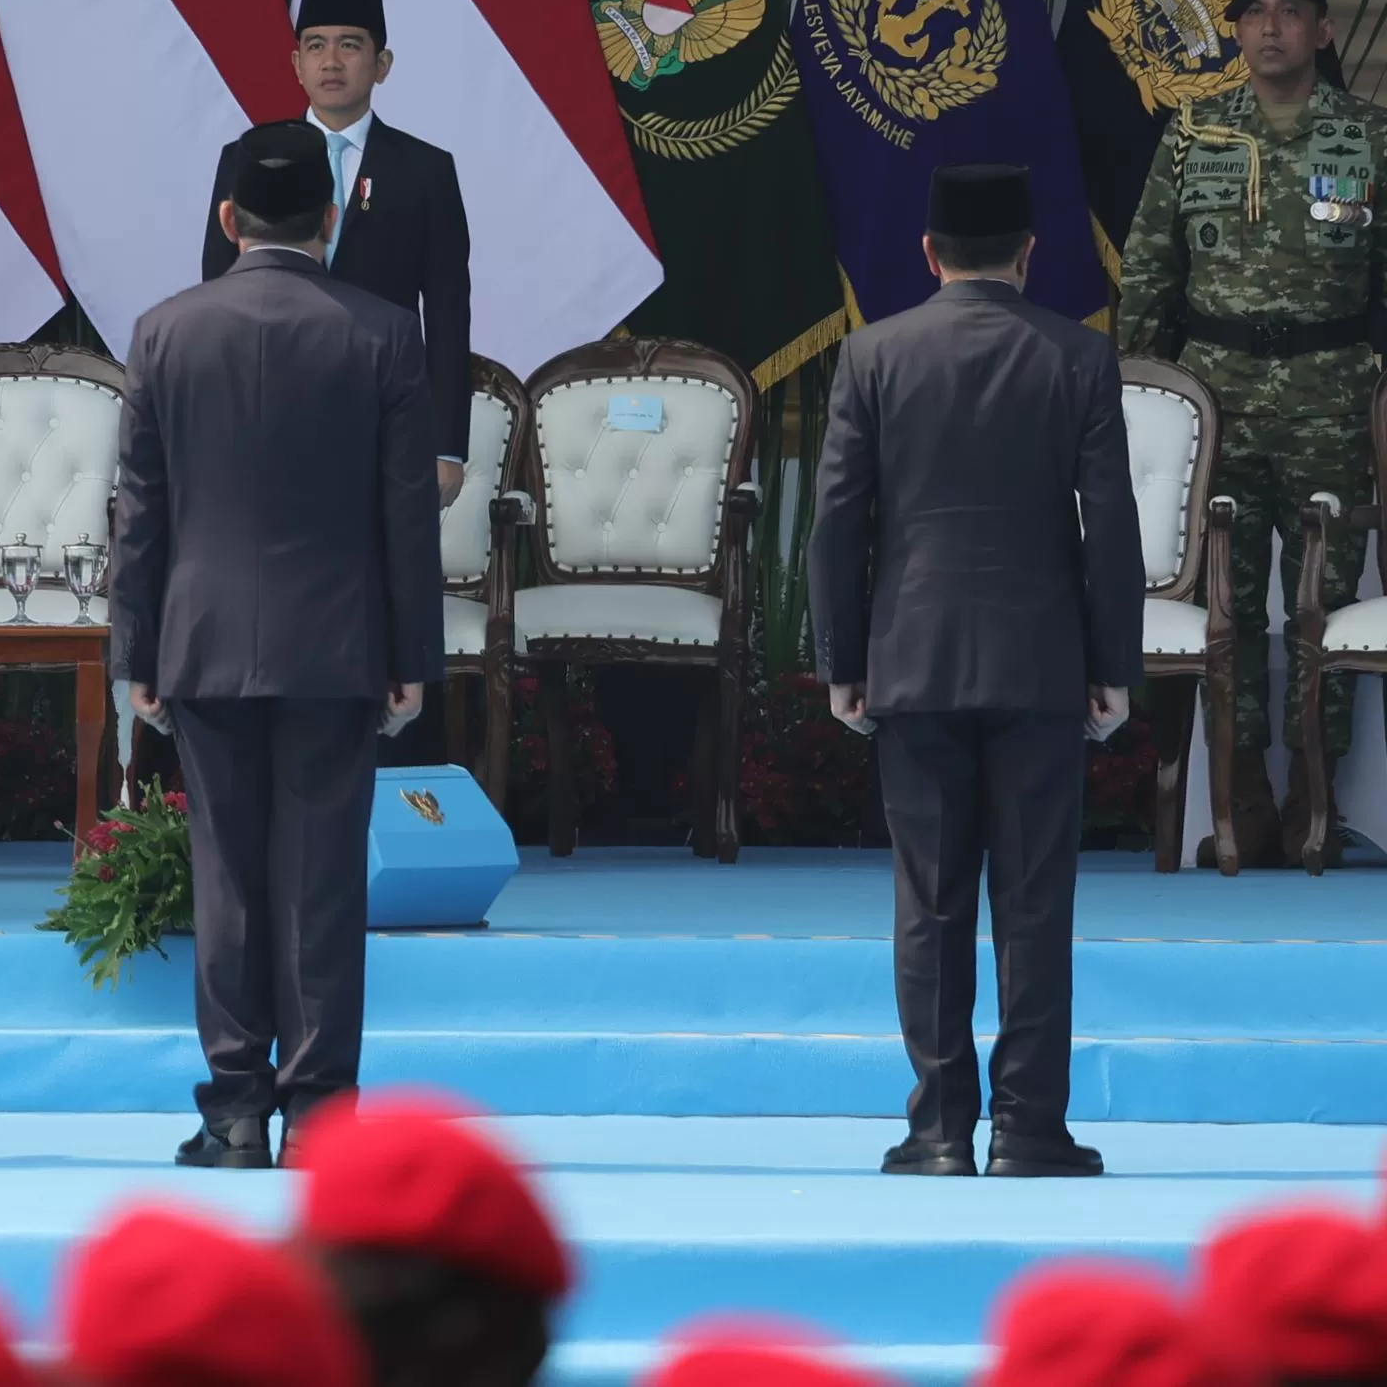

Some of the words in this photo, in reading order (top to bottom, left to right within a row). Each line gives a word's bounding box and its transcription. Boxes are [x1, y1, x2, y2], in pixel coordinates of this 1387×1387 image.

[836, 80, 915, 150] JAYAMAHE
[1185, 162, 1198, 175] EKO
[1199, 162, 1245, 175] HARDIANTO
[1311, 163, 1338, 176] TNI
[1346, 165, 1370, 180] AD
